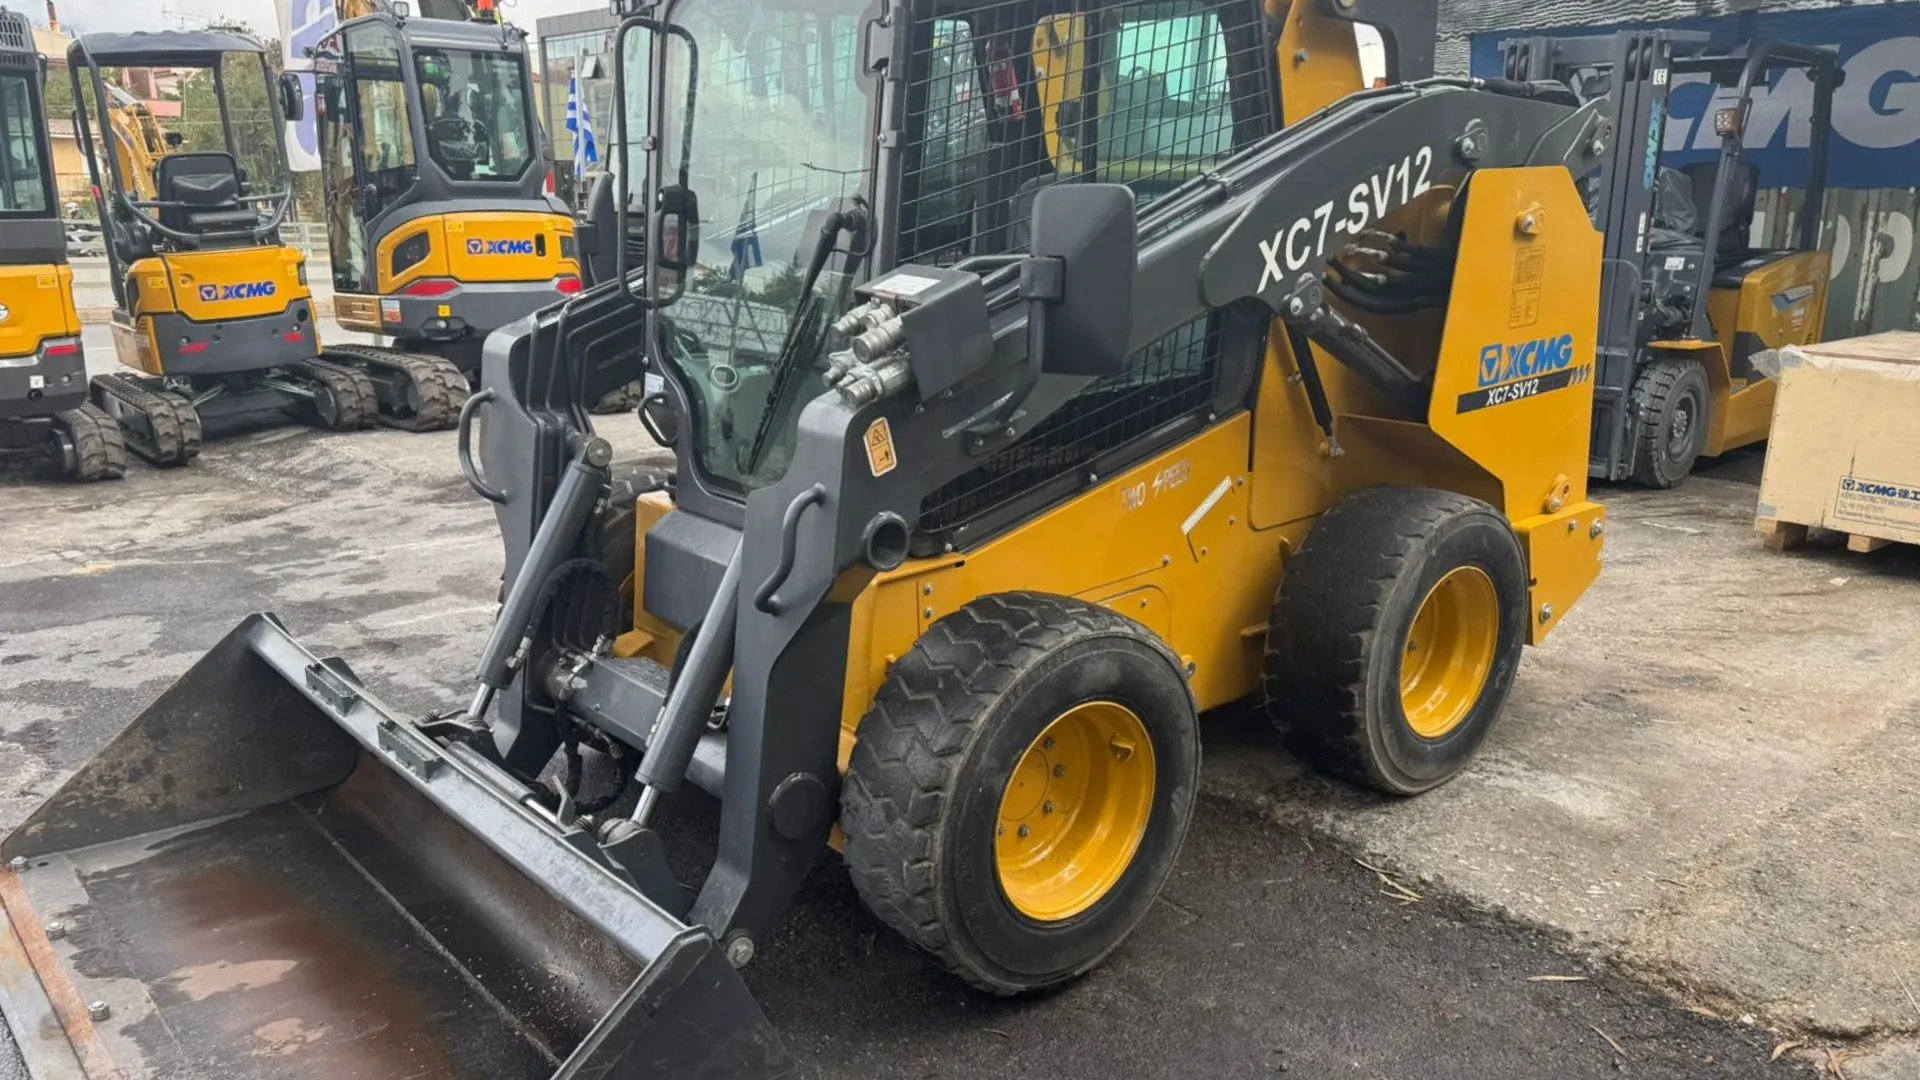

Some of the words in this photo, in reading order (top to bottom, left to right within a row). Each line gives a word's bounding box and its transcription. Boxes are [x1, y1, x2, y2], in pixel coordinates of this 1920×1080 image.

[1257, 145, 1432, 294] XC7-SV12
[485, 239, 533, 254] XCMG
[220, 280, 276, 299] XCMG
[1500, 333, 1573, 382] XCMG
[1485, 379, 1539, 407] XC7-SV12
[1856, 481, 1897, 497] XCMG
